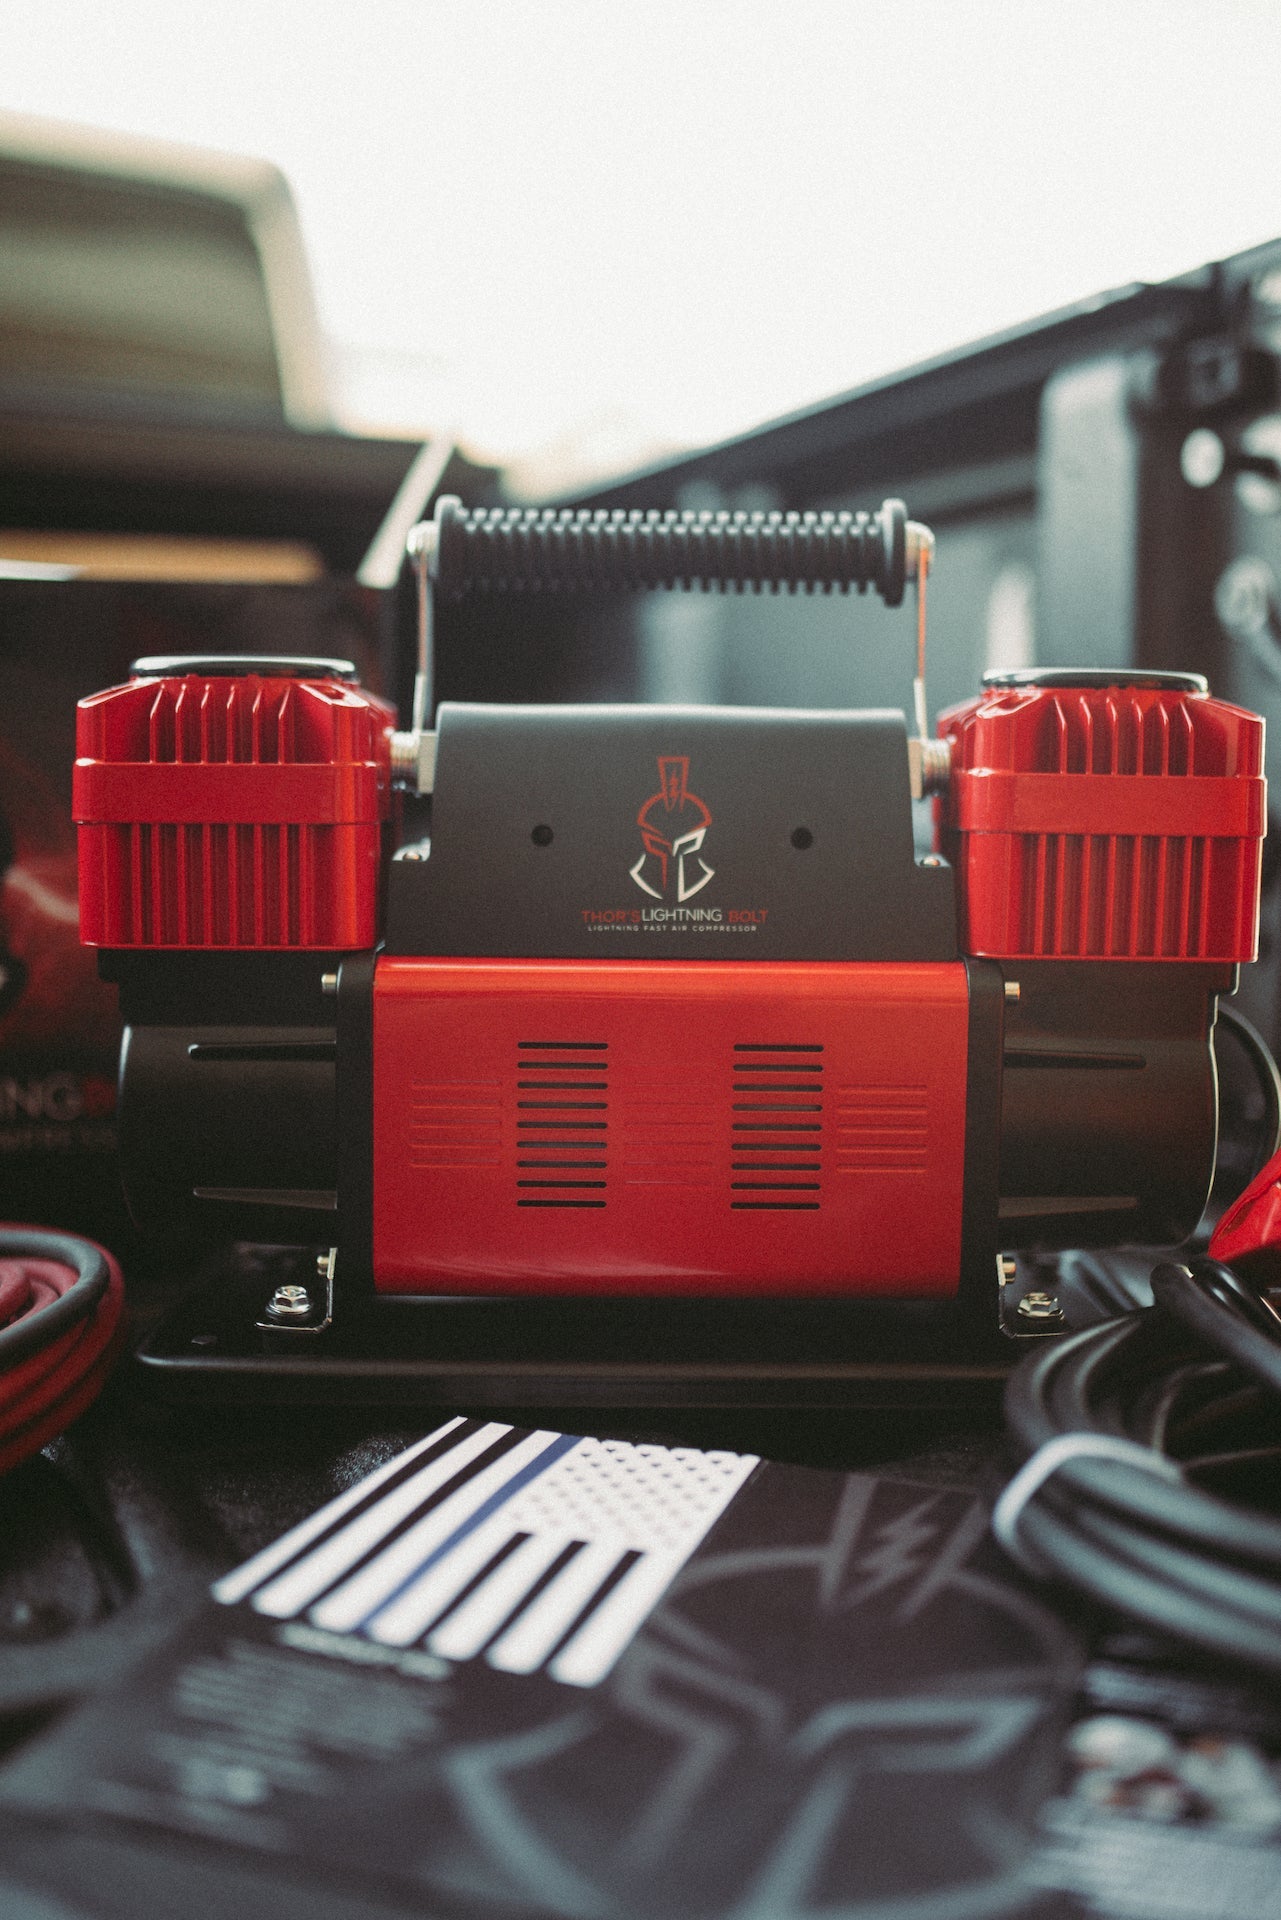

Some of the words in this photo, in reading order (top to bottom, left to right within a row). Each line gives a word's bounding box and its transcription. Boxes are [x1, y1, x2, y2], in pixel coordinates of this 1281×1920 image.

[641, 908, 722, 922] LIGHTNING
[728, 909, 768, 923] BOLT
[692, 925, 757, 933] COMPRESSOR
